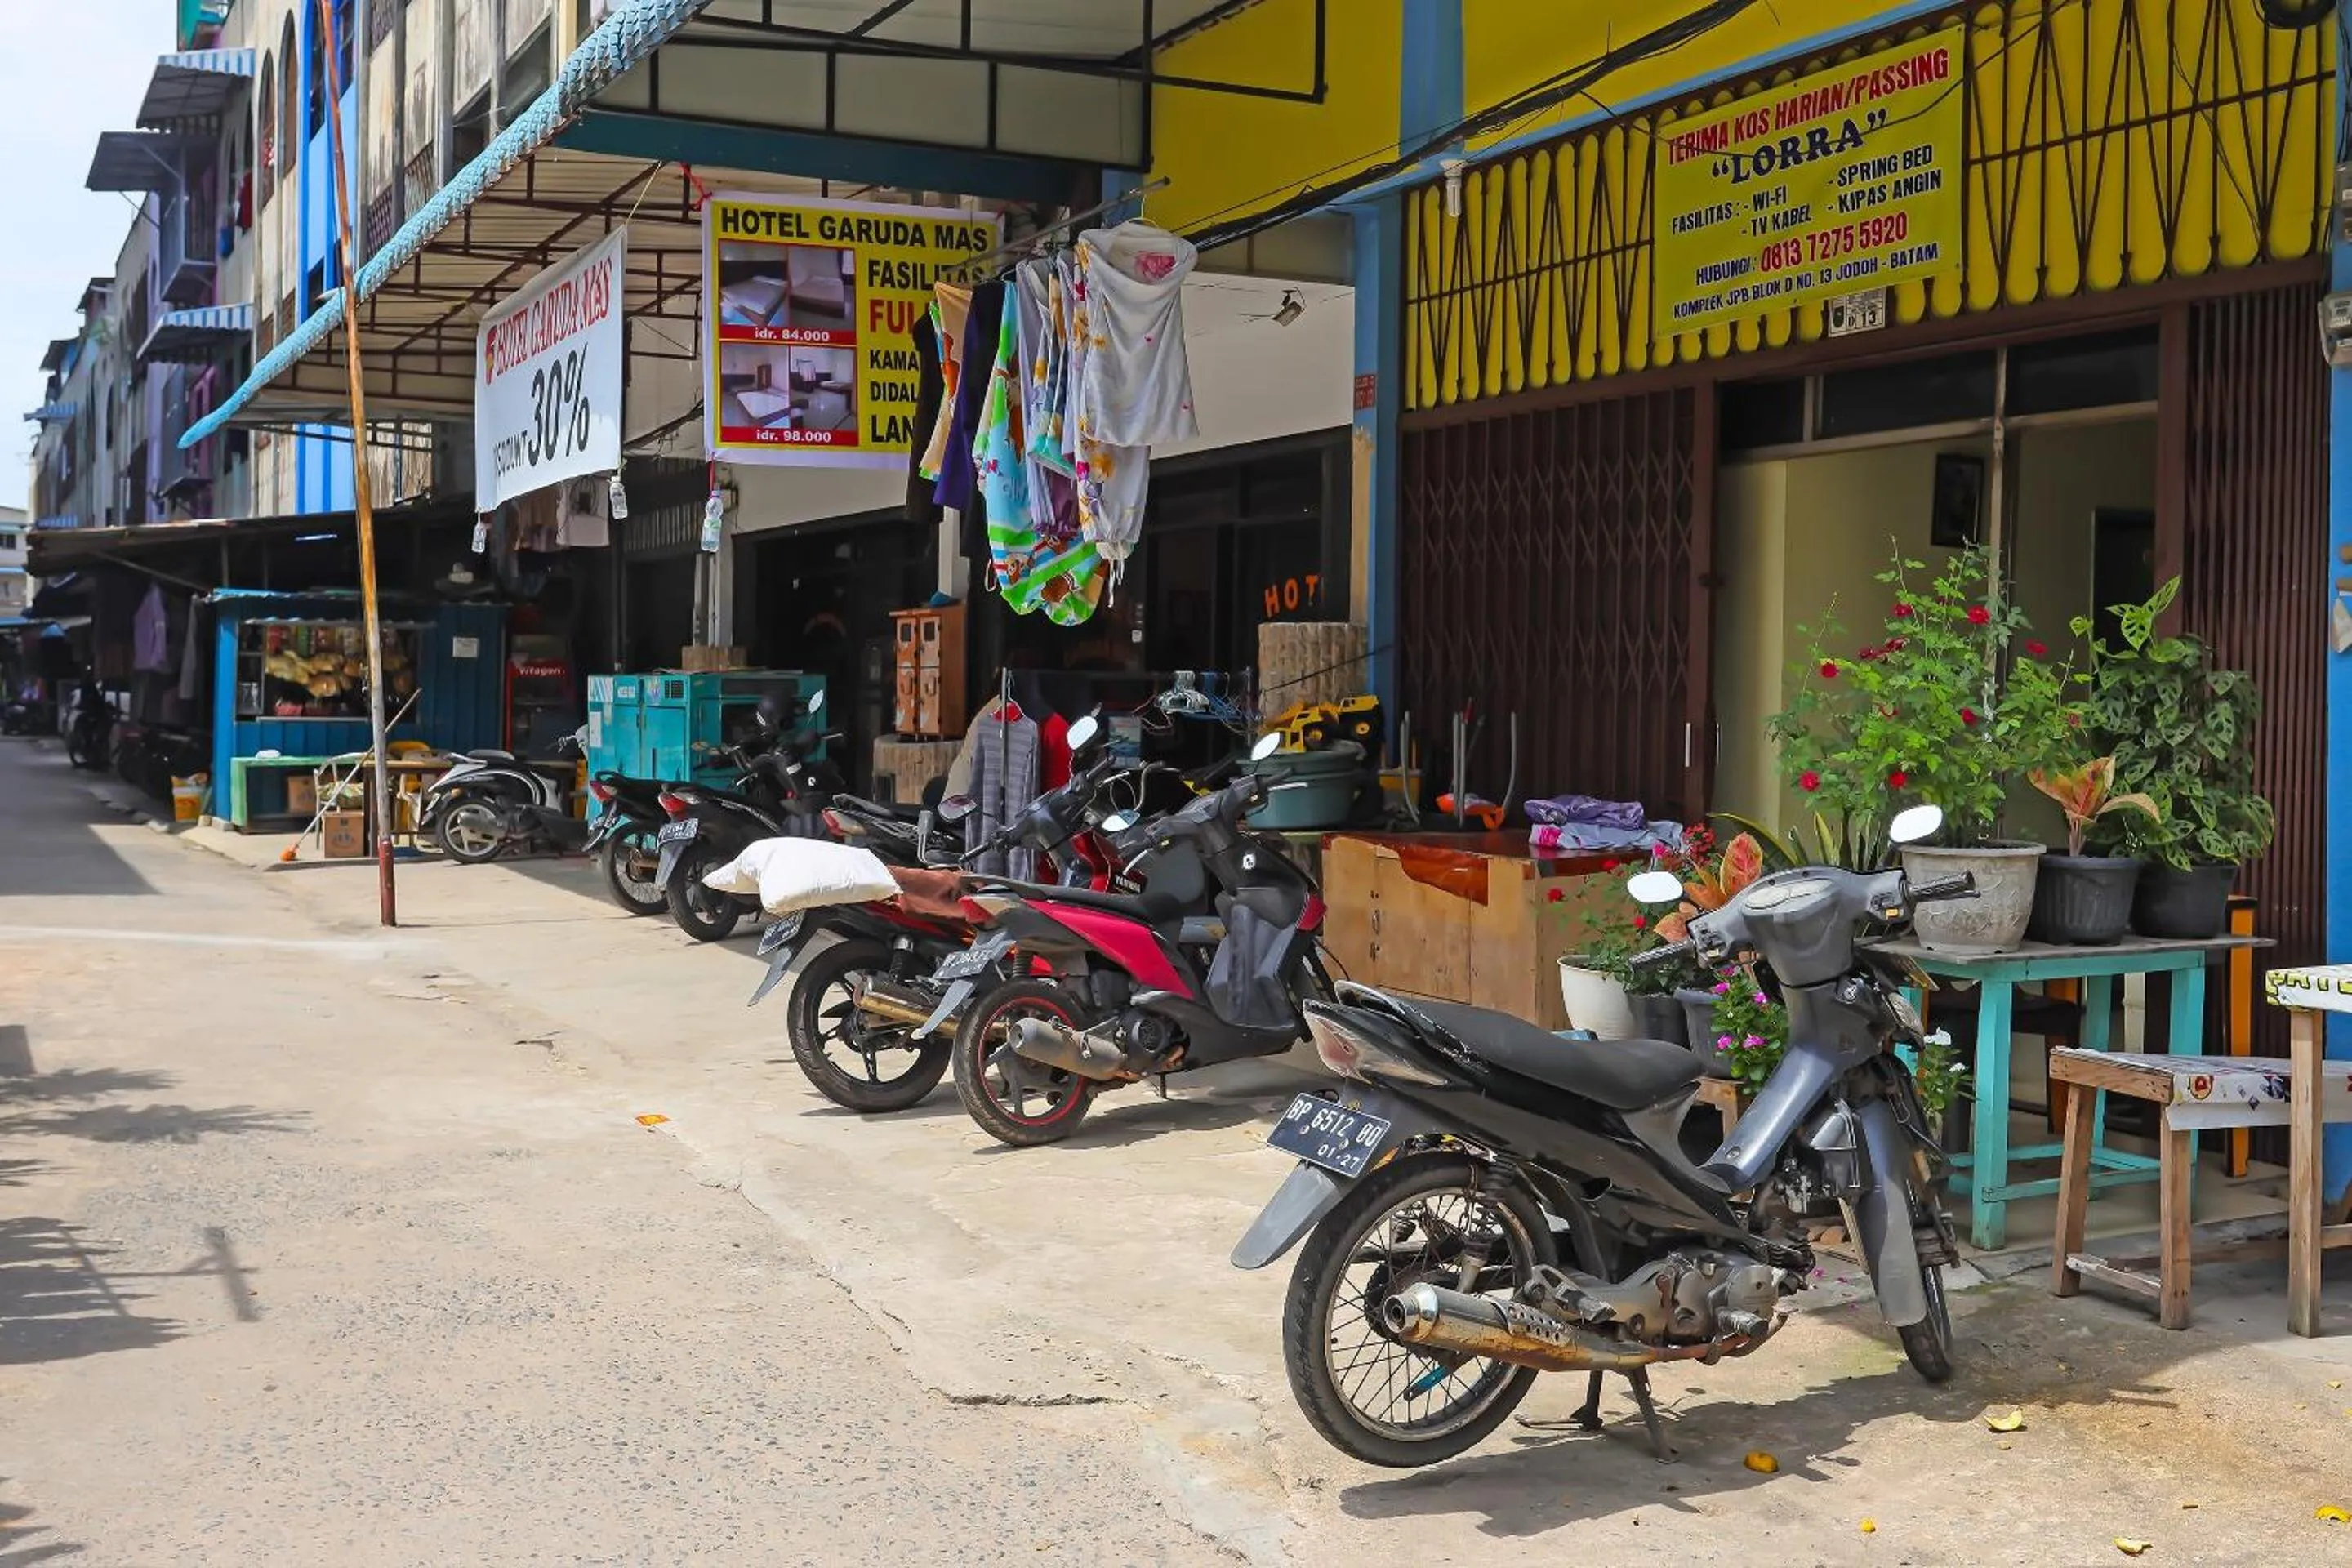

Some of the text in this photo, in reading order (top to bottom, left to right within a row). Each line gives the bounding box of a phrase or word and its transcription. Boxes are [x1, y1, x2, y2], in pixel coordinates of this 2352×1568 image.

[1668, 48, 1949, 165] TERIMA KOS HARIAN/PASSING
[1838, 156, 1898, 188] SPRING
[1902, 145, 1933, 171] BED
[1753, 185, 1787, 212] WI-FI
[1838, 184, 1887, 214] KIPAS
[1892, 168, 1942, 200] ANGIN
[721, 207, 988, 252] HOTEL GARUDA MAS
[1751, 216, 1769, 237] TV
[1772, 204, 1812, 232] KABEL
[1760, 238, 1802, 274] 0813
[1806, 225, 1855, 263] 7275
[1859, 211, 1908, 251] 5920
[1673, 292, 1722, 319] KOMPLEK
[1726, 285, 1749, 306] JPB
[1752, 278, 1782, 299] BLOK
[1784, 276, 1793, 292] D
[1796, 272, 1815, 290] NO.
[1819, 268, 1833, 285] 13
[1836, 256, 1878, 281] JODOH
[1890, 242, 1940, 270] BATAM
[755, 327, 831, 342] idr. 84.000
[1862, 310, 1877, 327] 13
[497, 307, 529, 376] HOTEL
[528, 341, 590, 467] 30%
[755, 429, 831, 443] idr. 98.000
[1286, 1099, 1313, 1122] BP
[1310, 1107, 1356, 1138] 6512
